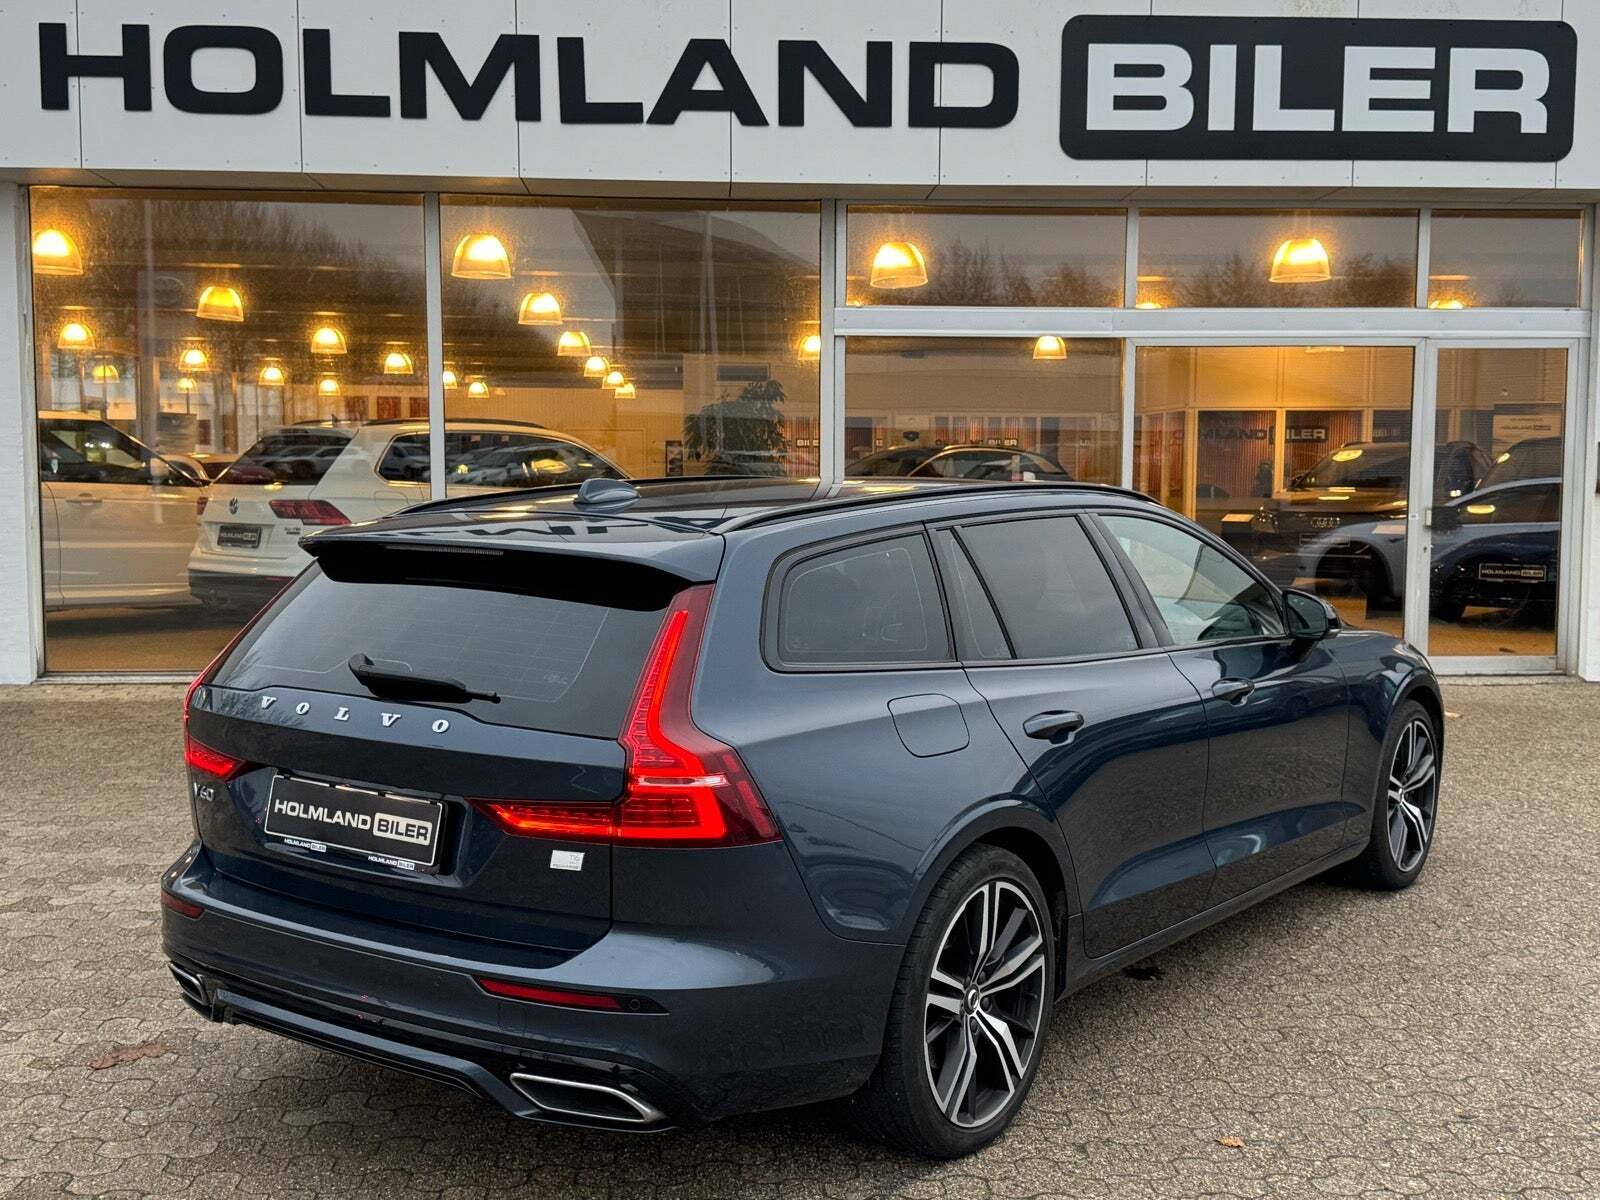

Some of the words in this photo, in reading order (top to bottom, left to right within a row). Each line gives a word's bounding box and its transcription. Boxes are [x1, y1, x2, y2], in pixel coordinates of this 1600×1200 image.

[38, 22, 1020, 129] HOLMLAND
[1086, 43, 1550, 134] BILER
[261, 695, 449, 733] VOLVO
[274, 799, 372, 830] HOLMLAND
[377, 819, 429, 841] BILER
[284, 838, 311, 848] HOLMLAND
[368, 855, 398, 866] HOLMLAND
[398, 861, 415, 870] BILER
